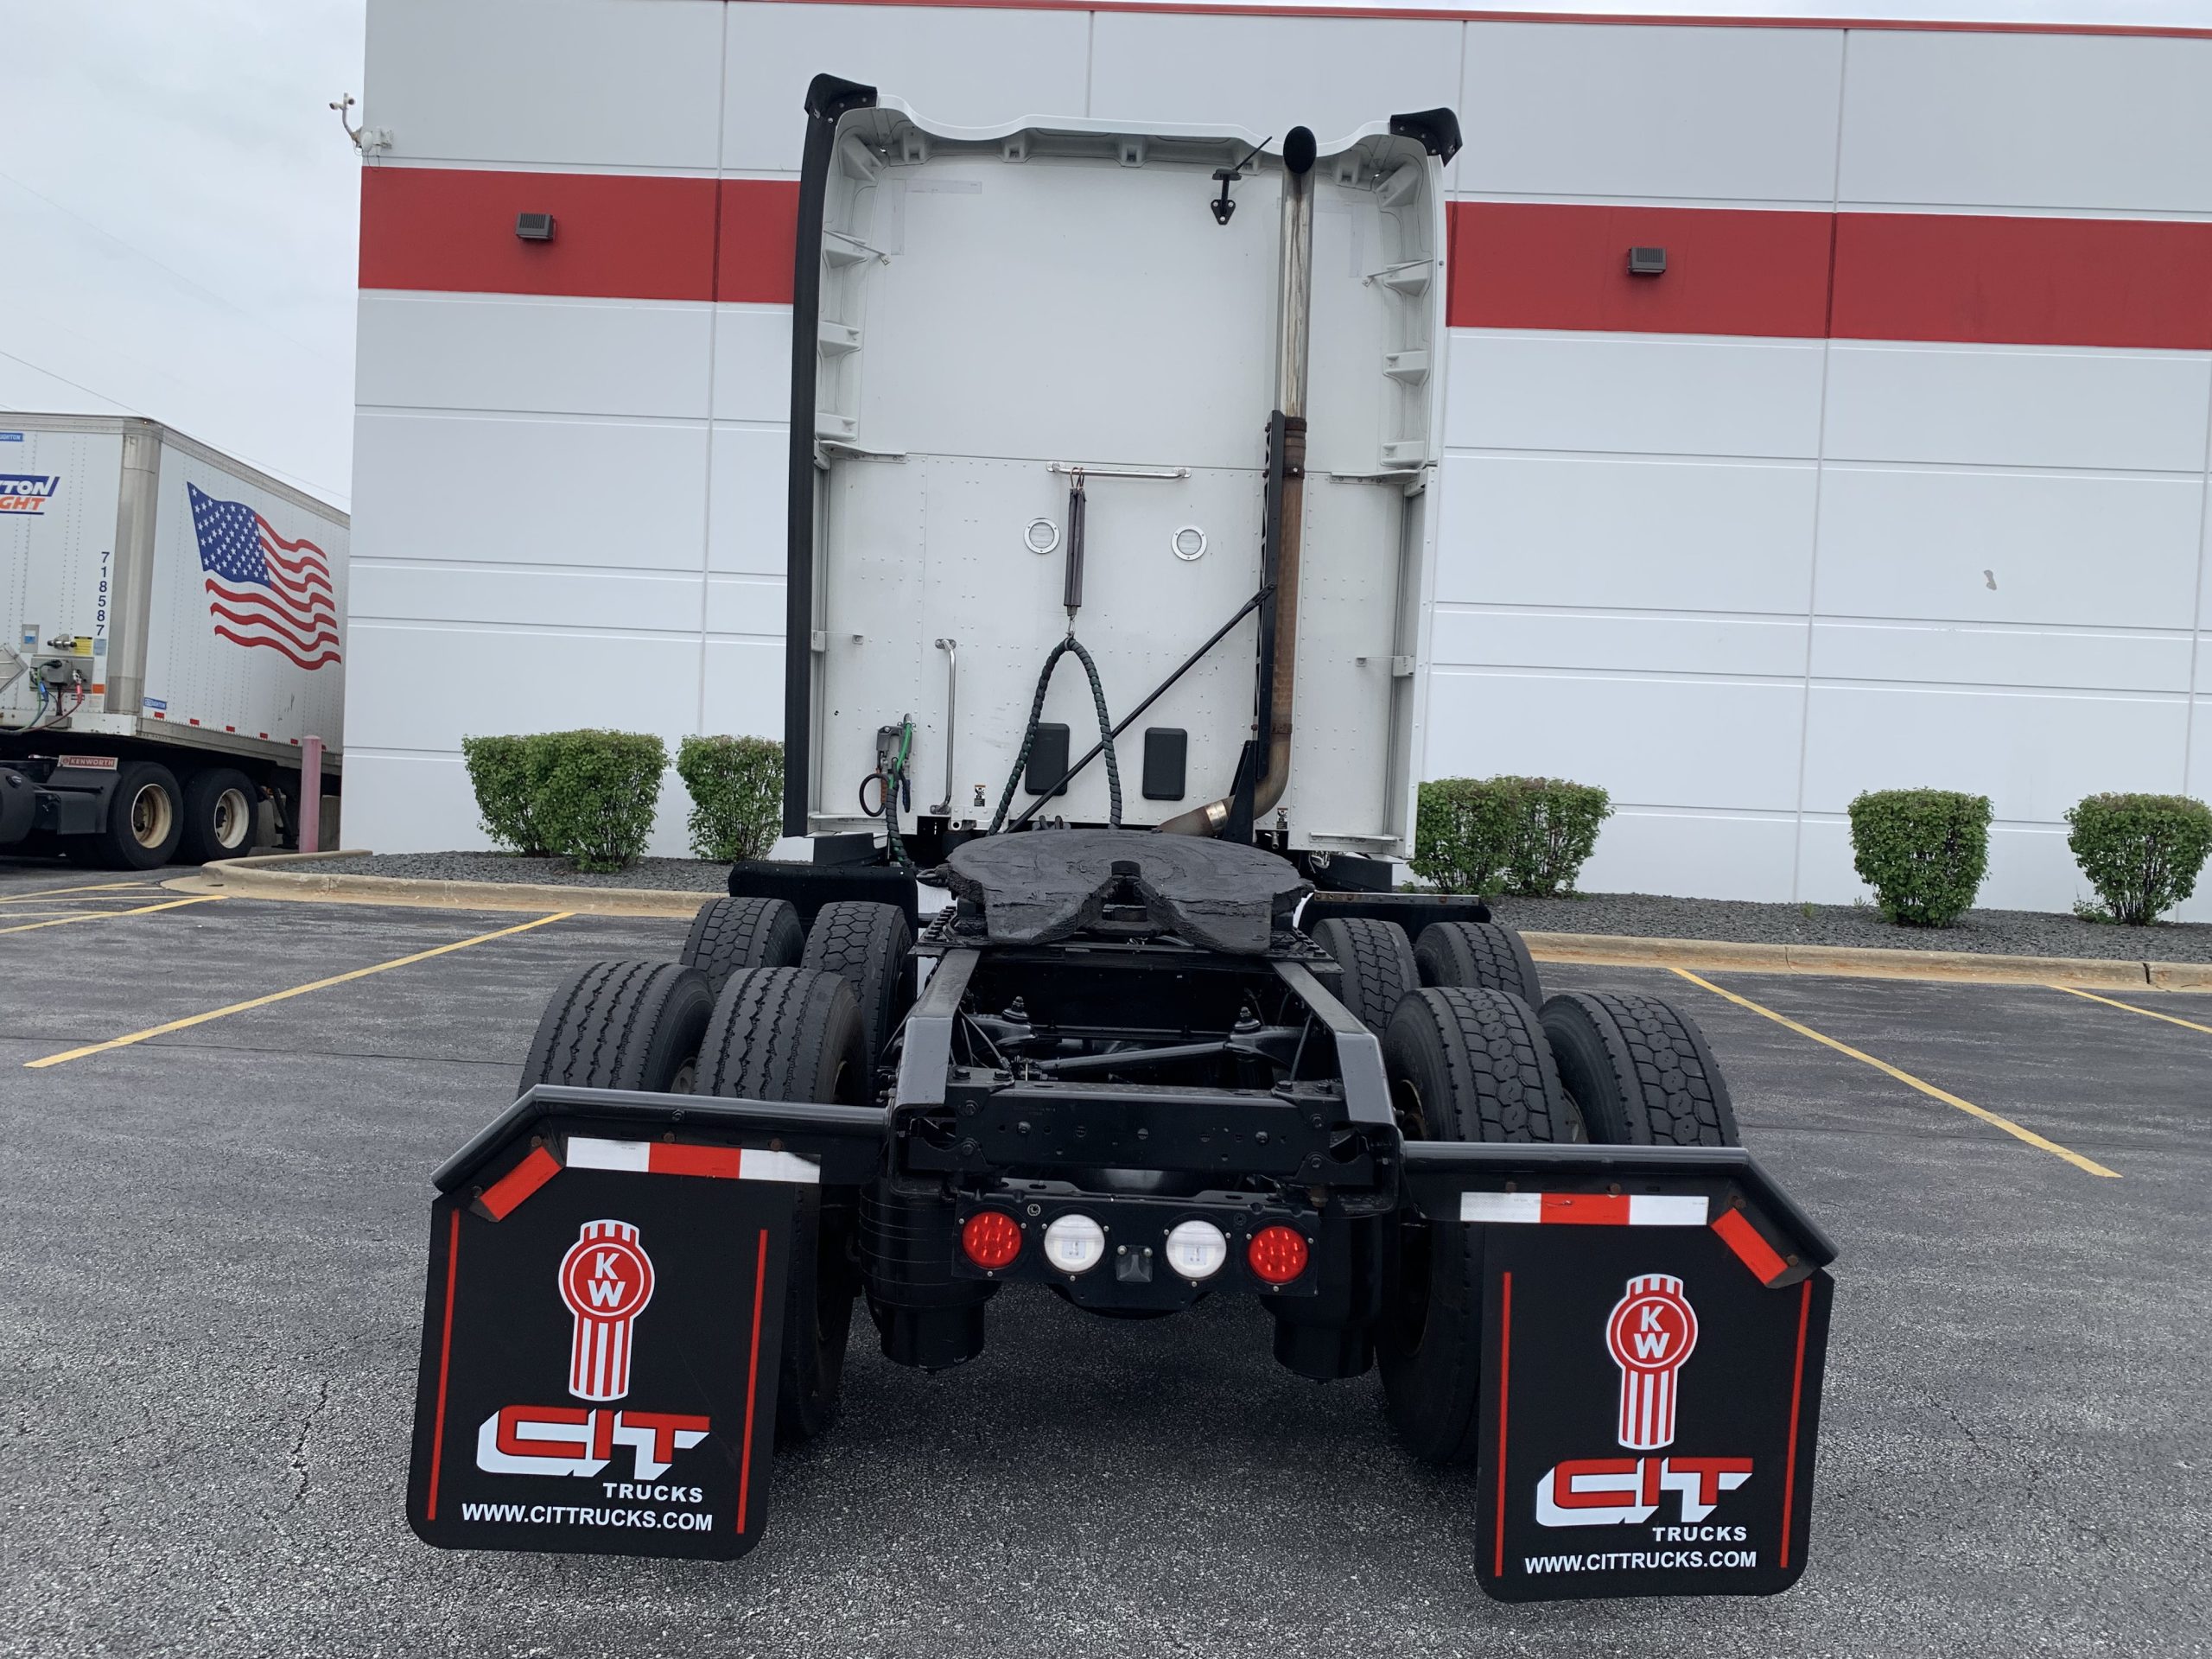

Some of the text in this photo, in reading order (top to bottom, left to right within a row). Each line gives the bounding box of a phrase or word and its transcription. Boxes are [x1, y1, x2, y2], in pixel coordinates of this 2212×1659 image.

[0, 480, 53, 495] TON
[97, 551, 110, 636] 718587
[477, 1404, 710, 1480] CIT
[604, 1483, 703, 1503] TRUCKS
[1537, 1458, 1753, 1527] CIT
[462, 1503, 713, 1531] WWW.CITTRUCKS.COM
[1653, 1527, 1747, 1541] TRUCKS
[1525, 1552, 1757, 1573] WWW.CITTRUCKS.COM
